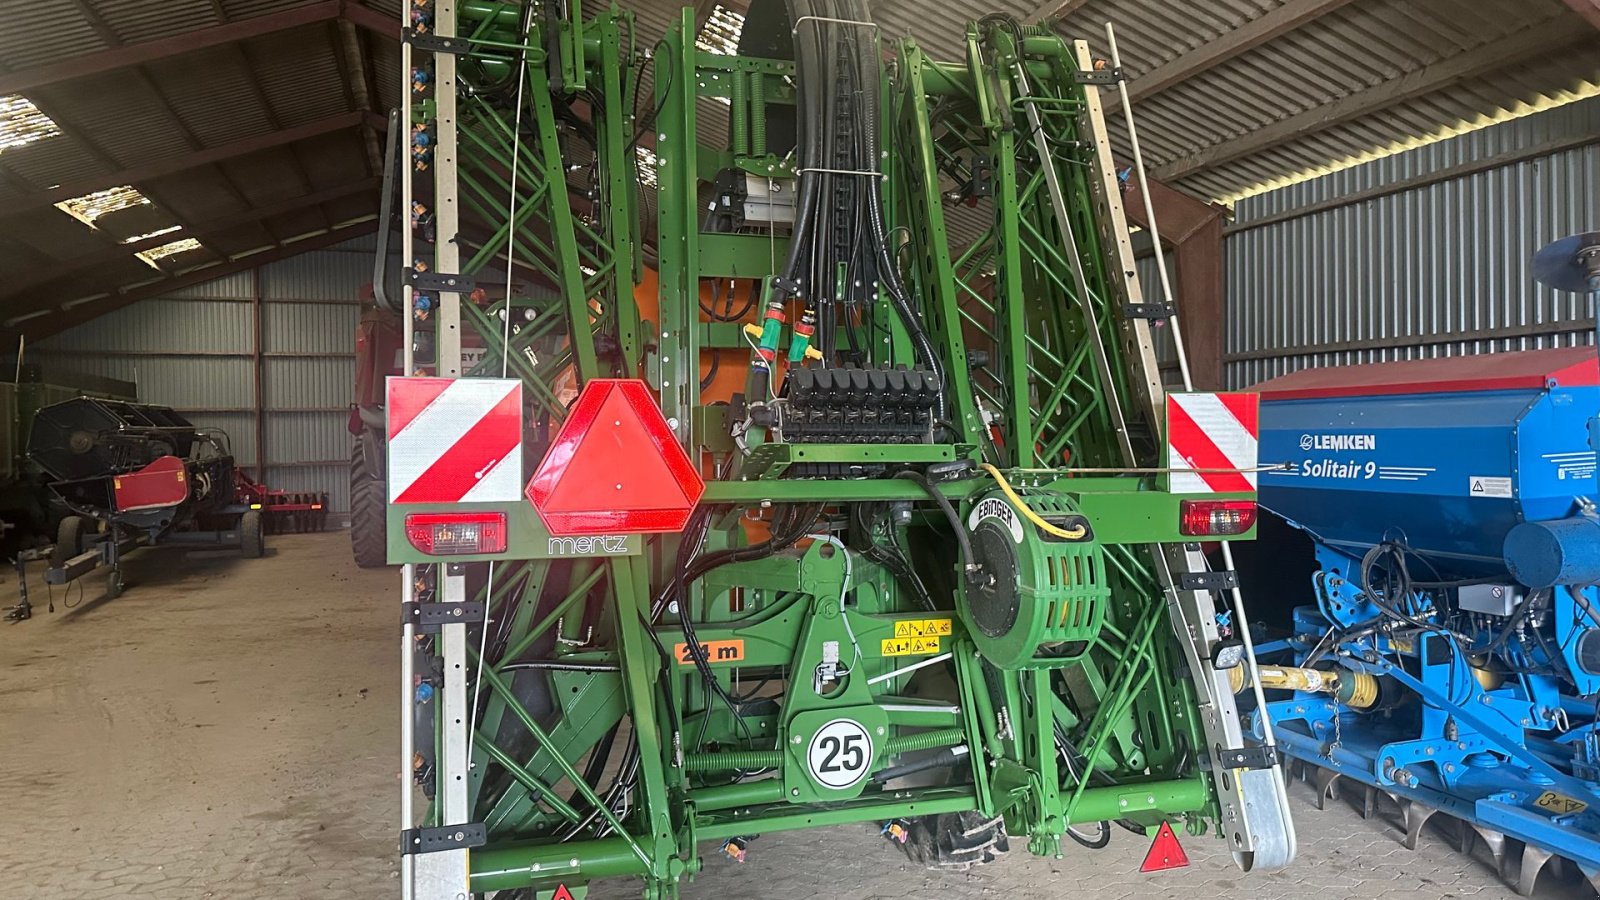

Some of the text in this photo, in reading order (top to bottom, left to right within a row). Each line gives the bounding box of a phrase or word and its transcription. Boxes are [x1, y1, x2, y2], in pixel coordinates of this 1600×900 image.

[1314, 434, 1376, 452] LEMKEN
[1301, 459, 1376, 480] Solitair 9
[548, 534, 628, 554] mertz
[718, 646, 738, 660] m
[819, 734, 864, 773] 25
